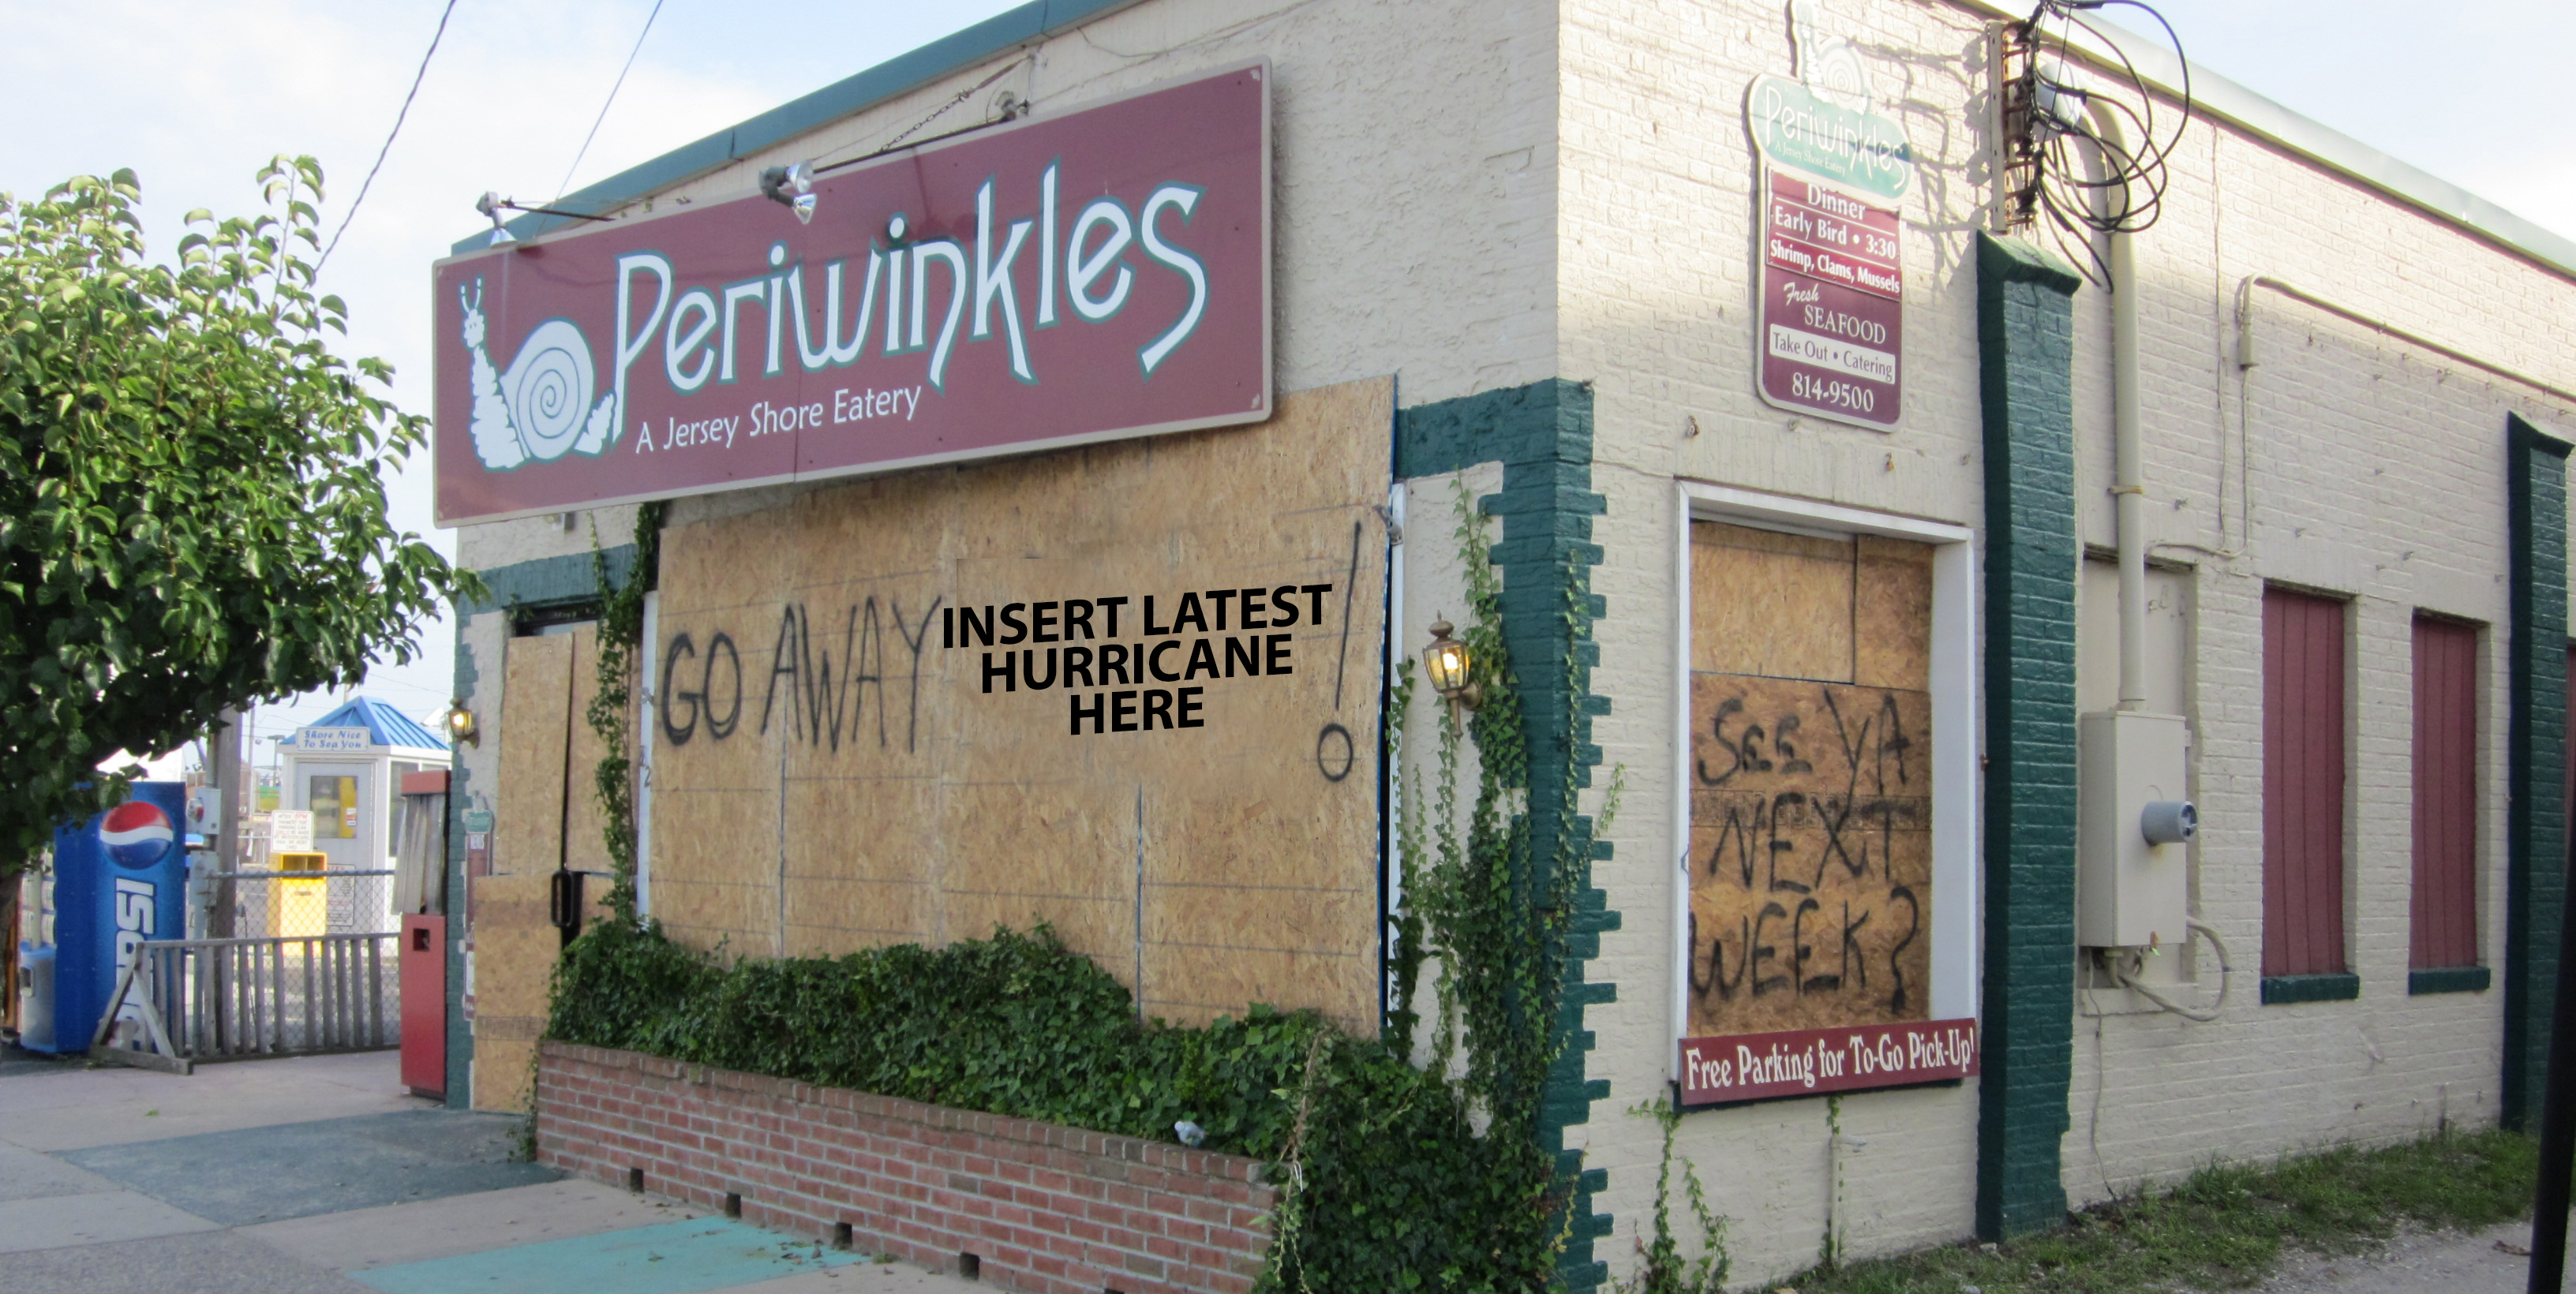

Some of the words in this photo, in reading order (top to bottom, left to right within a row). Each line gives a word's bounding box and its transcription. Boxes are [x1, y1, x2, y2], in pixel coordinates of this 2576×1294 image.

[1765, 85, 1908, 190] Periwinkles
[1775, 140, 1781, 151] A
[1782, 142, 1802, 161] Jersey
[1803, 150, 1823, 166] Shore
[1825, 158, 1847, 177] Eatery
[1807, 183, 1866, 220] Dinner
[1775, 205, 1813, 240] Early
[1818, 219, 1847, 245] Bird
[1865, 234, 1896, 260] 3:30
[1770, 239, 1815, 273] Shrimp,
[1817, 254, 1855, 285] Clams,
[1857, 266, 1900, 294] Mussels
[1783, 282, 1821, 306] Fresh
[612, 155, 1210, 451] Periwinkles
[1804, 305, 1886, 345] SEAFOOD
[1773, 332, 1802, 354] Take
[1804, 340, 1829, 362] Out
[1843, 350, 1893, 383] Catering
[635, 421, 654, 454] A
[663, 415, 739, 451] Jersey
[749, 402, 824, 437] Shore
[833, 385, 922, 424] Eatery
[1792, 371, 1875, 413] 814-9500
[661, 631, 742, 747] GO
[761, 594, 942, 754] AWAY
[341, 740, 361, 750] You
[1824, 687, 1910, 821] YA
[1709, 791, 1915, 893] NEXT
[1686, 1048, 1733, 1090] Free
[1737, 1043, 1815, 1087] Parking
[1818, 1038, 1844, 1077] for
[1849, 1033, 1904, 1074] To-Go
